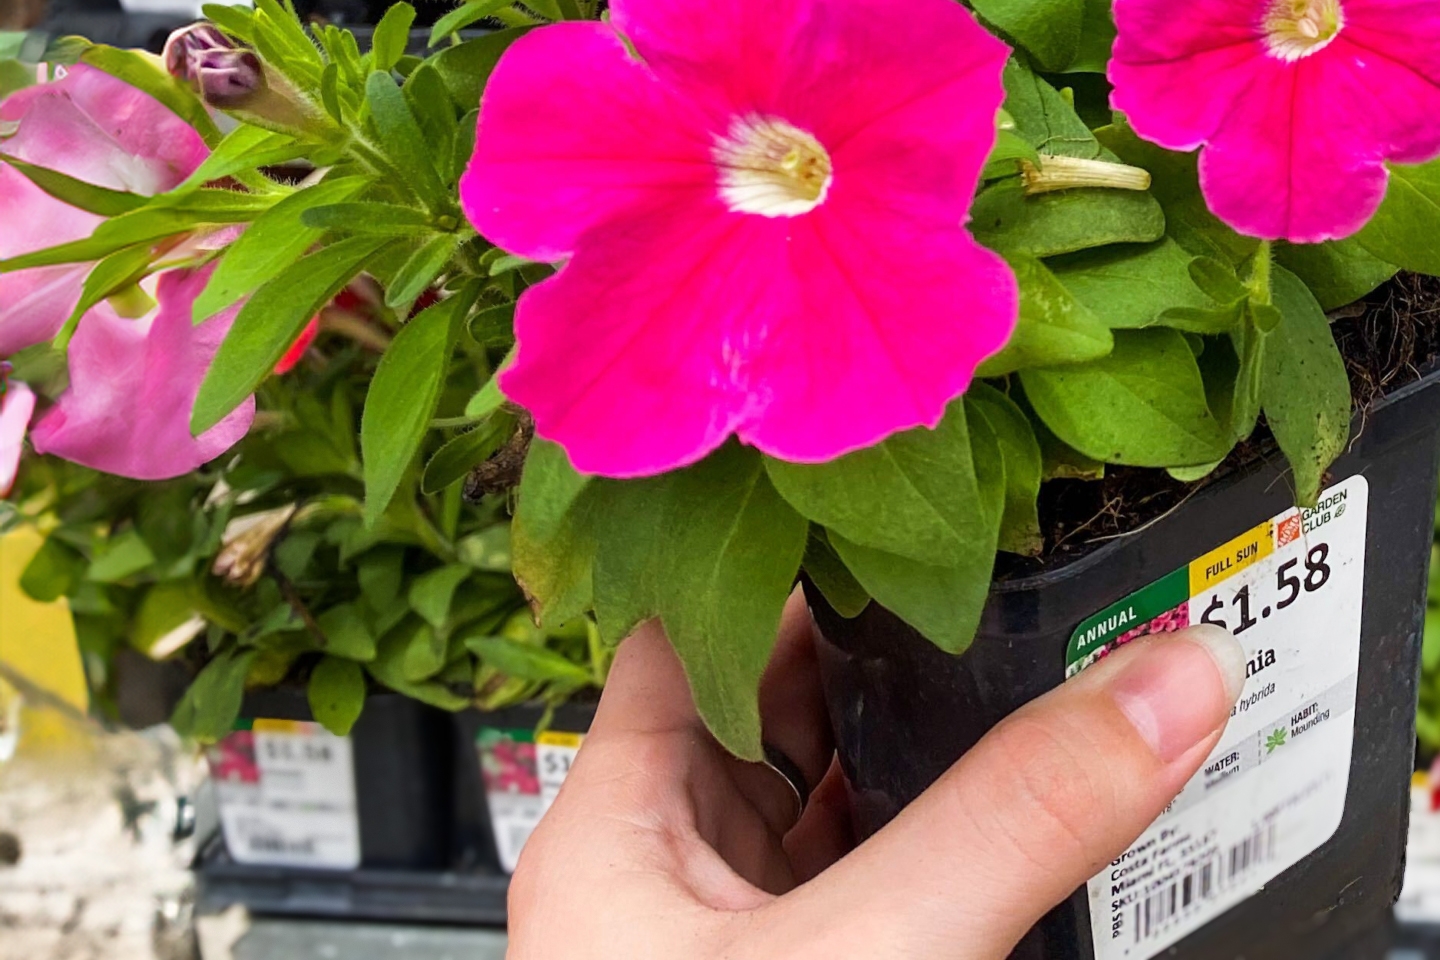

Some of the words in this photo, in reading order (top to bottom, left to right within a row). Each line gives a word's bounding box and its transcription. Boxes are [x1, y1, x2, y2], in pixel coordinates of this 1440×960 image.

[1302, 488, 1347, 520] GARDEN
[1302, 511, 1331, 534] CLUB
[1206, 560, 1233, 580] FULL
[1236, 541, 1258, 563] SUN
[1200, 543, 1331, 636] $1.58
[1077, 606, 1137, 650] ANNUAL
[1239, 683, 1276, 713] hybrida
[1291, 702, 1319, 727] HABIT:
[1291, 709, 1330, 739] Mounding
[1111, 858, 1148, 882] Costa
